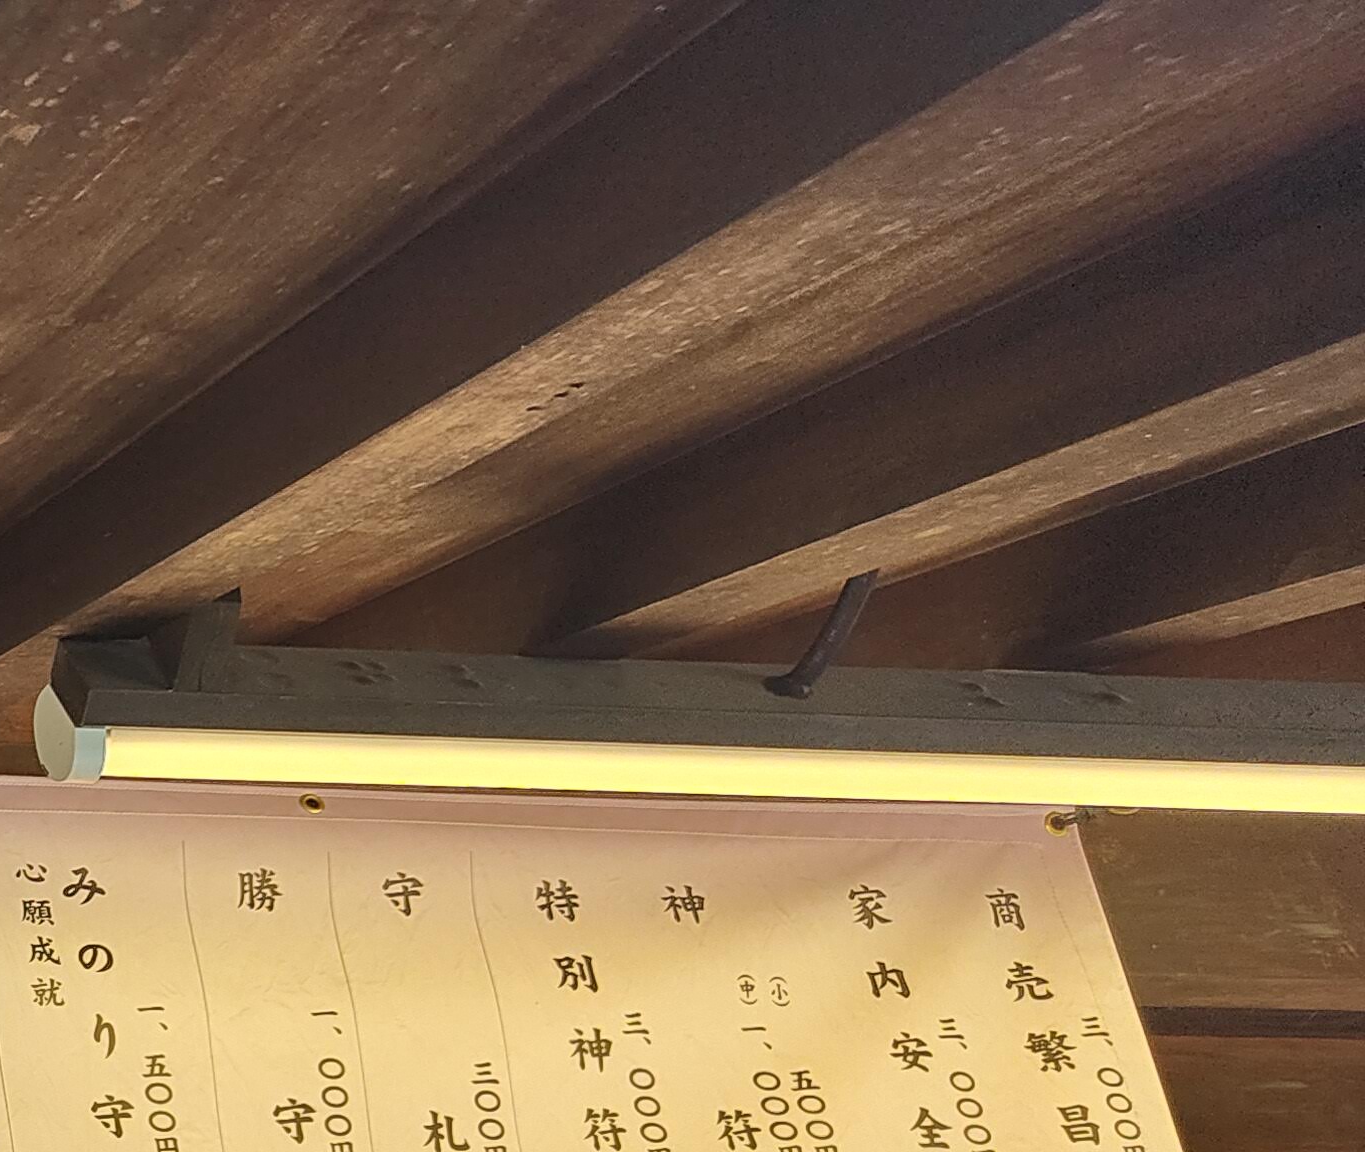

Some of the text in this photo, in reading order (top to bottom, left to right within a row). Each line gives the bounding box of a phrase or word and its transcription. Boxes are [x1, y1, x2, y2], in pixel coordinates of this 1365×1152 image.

[15, 863, 135, 1139] 心願成就 みのり守
[237, 867, 317, 1145] 勝守
[535, 879, 627, 1152] 特別神符
[660, 885, 762, 1151] 神符
[848, 884, 953, 1150] 家内安全
[985, 888, 1101, 1146] 商売繁昌
